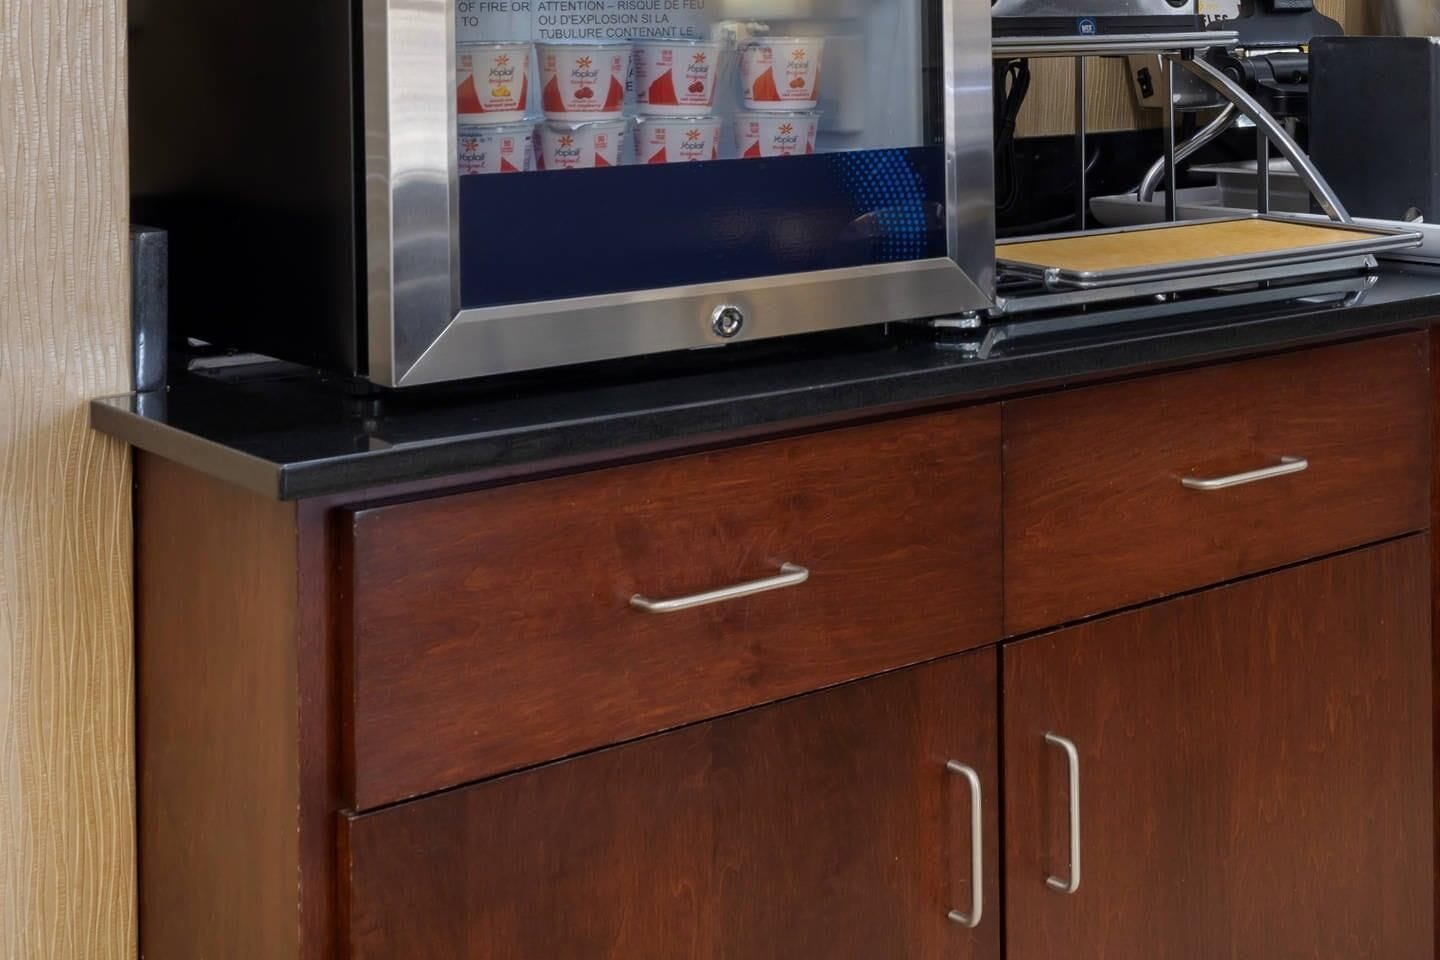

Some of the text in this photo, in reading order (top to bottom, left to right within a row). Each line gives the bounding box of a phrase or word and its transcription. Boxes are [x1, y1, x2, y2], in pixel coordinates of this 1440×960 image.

[458, 1, 530, 13] OF FIRE OR
[538, 1, 605, 11] ATTENTION
[617, 0, 662, 11] RISQUE
[664, 0, 680, 10] DE
[682, 0, 705, 10] FEU
[462, 16, 479, 27] TO
[538, 13, 669, 25] OU D'EXPLOSION SI LA
[539, 26, 693, 39] TUBULURE CONTENANT LE
